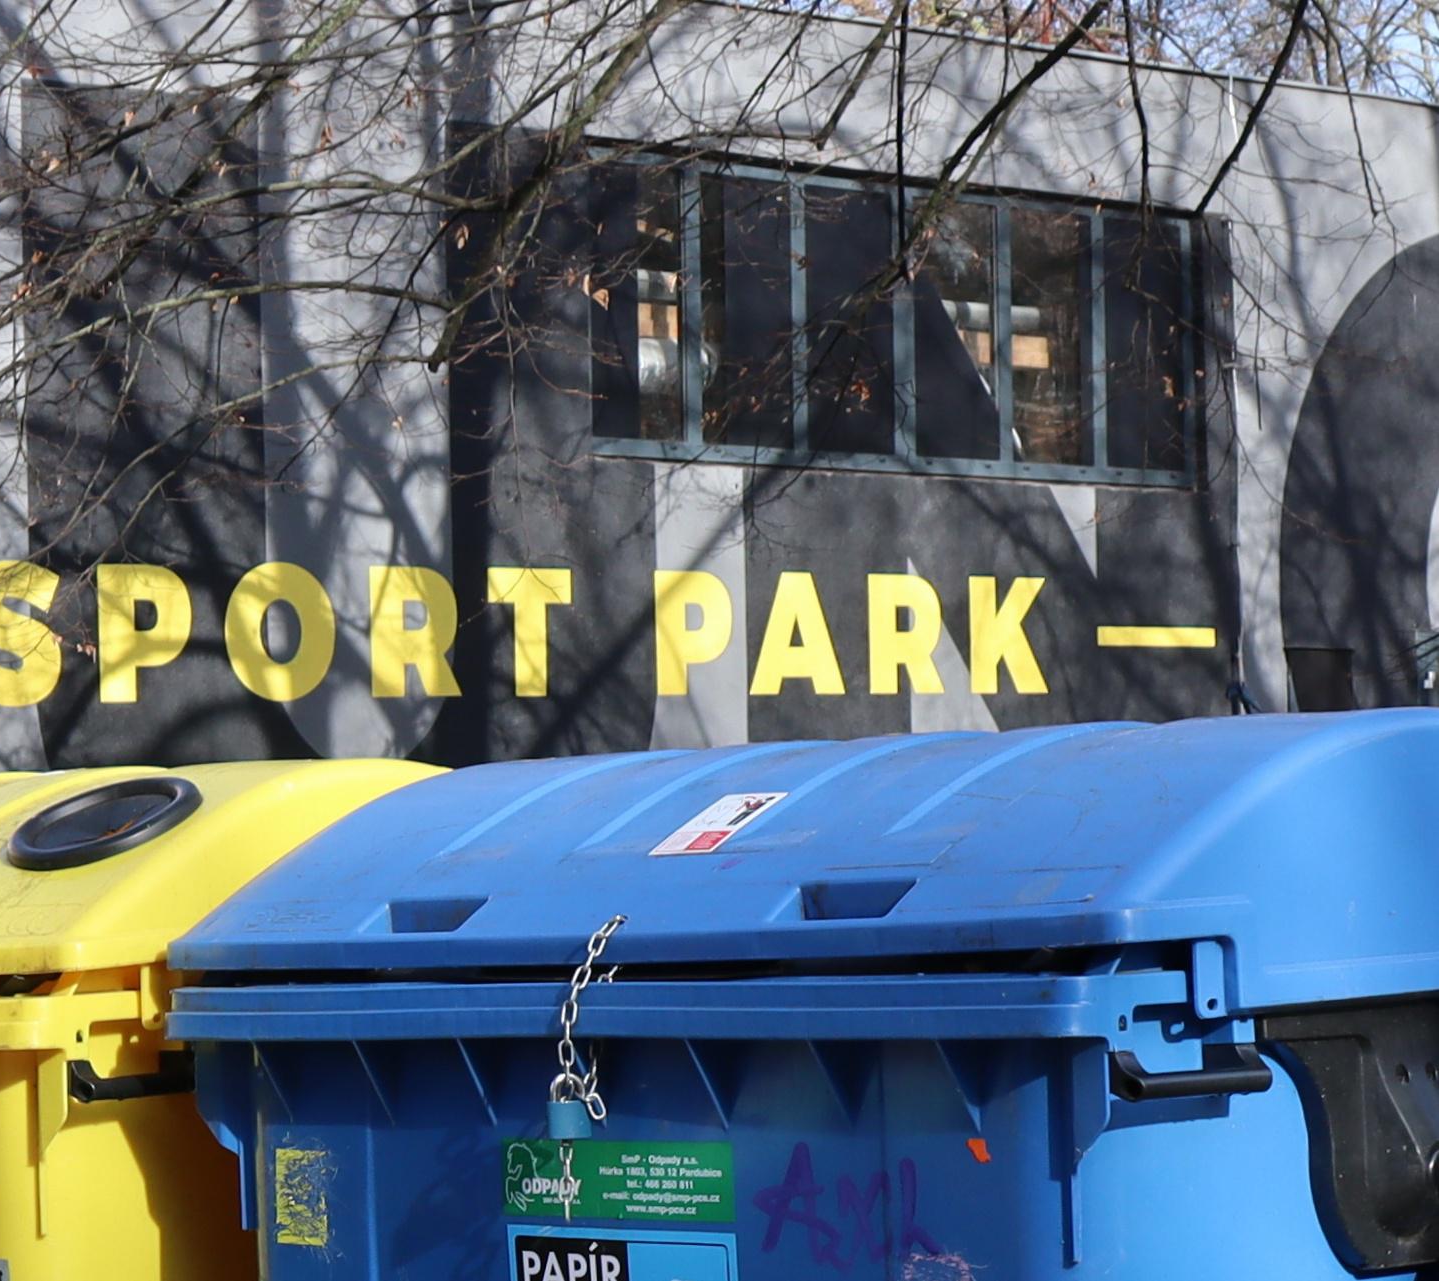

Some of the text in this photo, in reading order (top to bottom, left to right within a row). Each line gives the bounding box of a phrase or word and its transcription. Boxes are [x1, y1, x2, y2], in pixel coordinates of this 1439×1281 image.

[653, 570, 1049, 696] PARK
[648, 1154, 681, 1166] Odpady
[679, 1168, 722, 1177] Pardubice
[522, 1241, 621, 1281] PAPÍR
